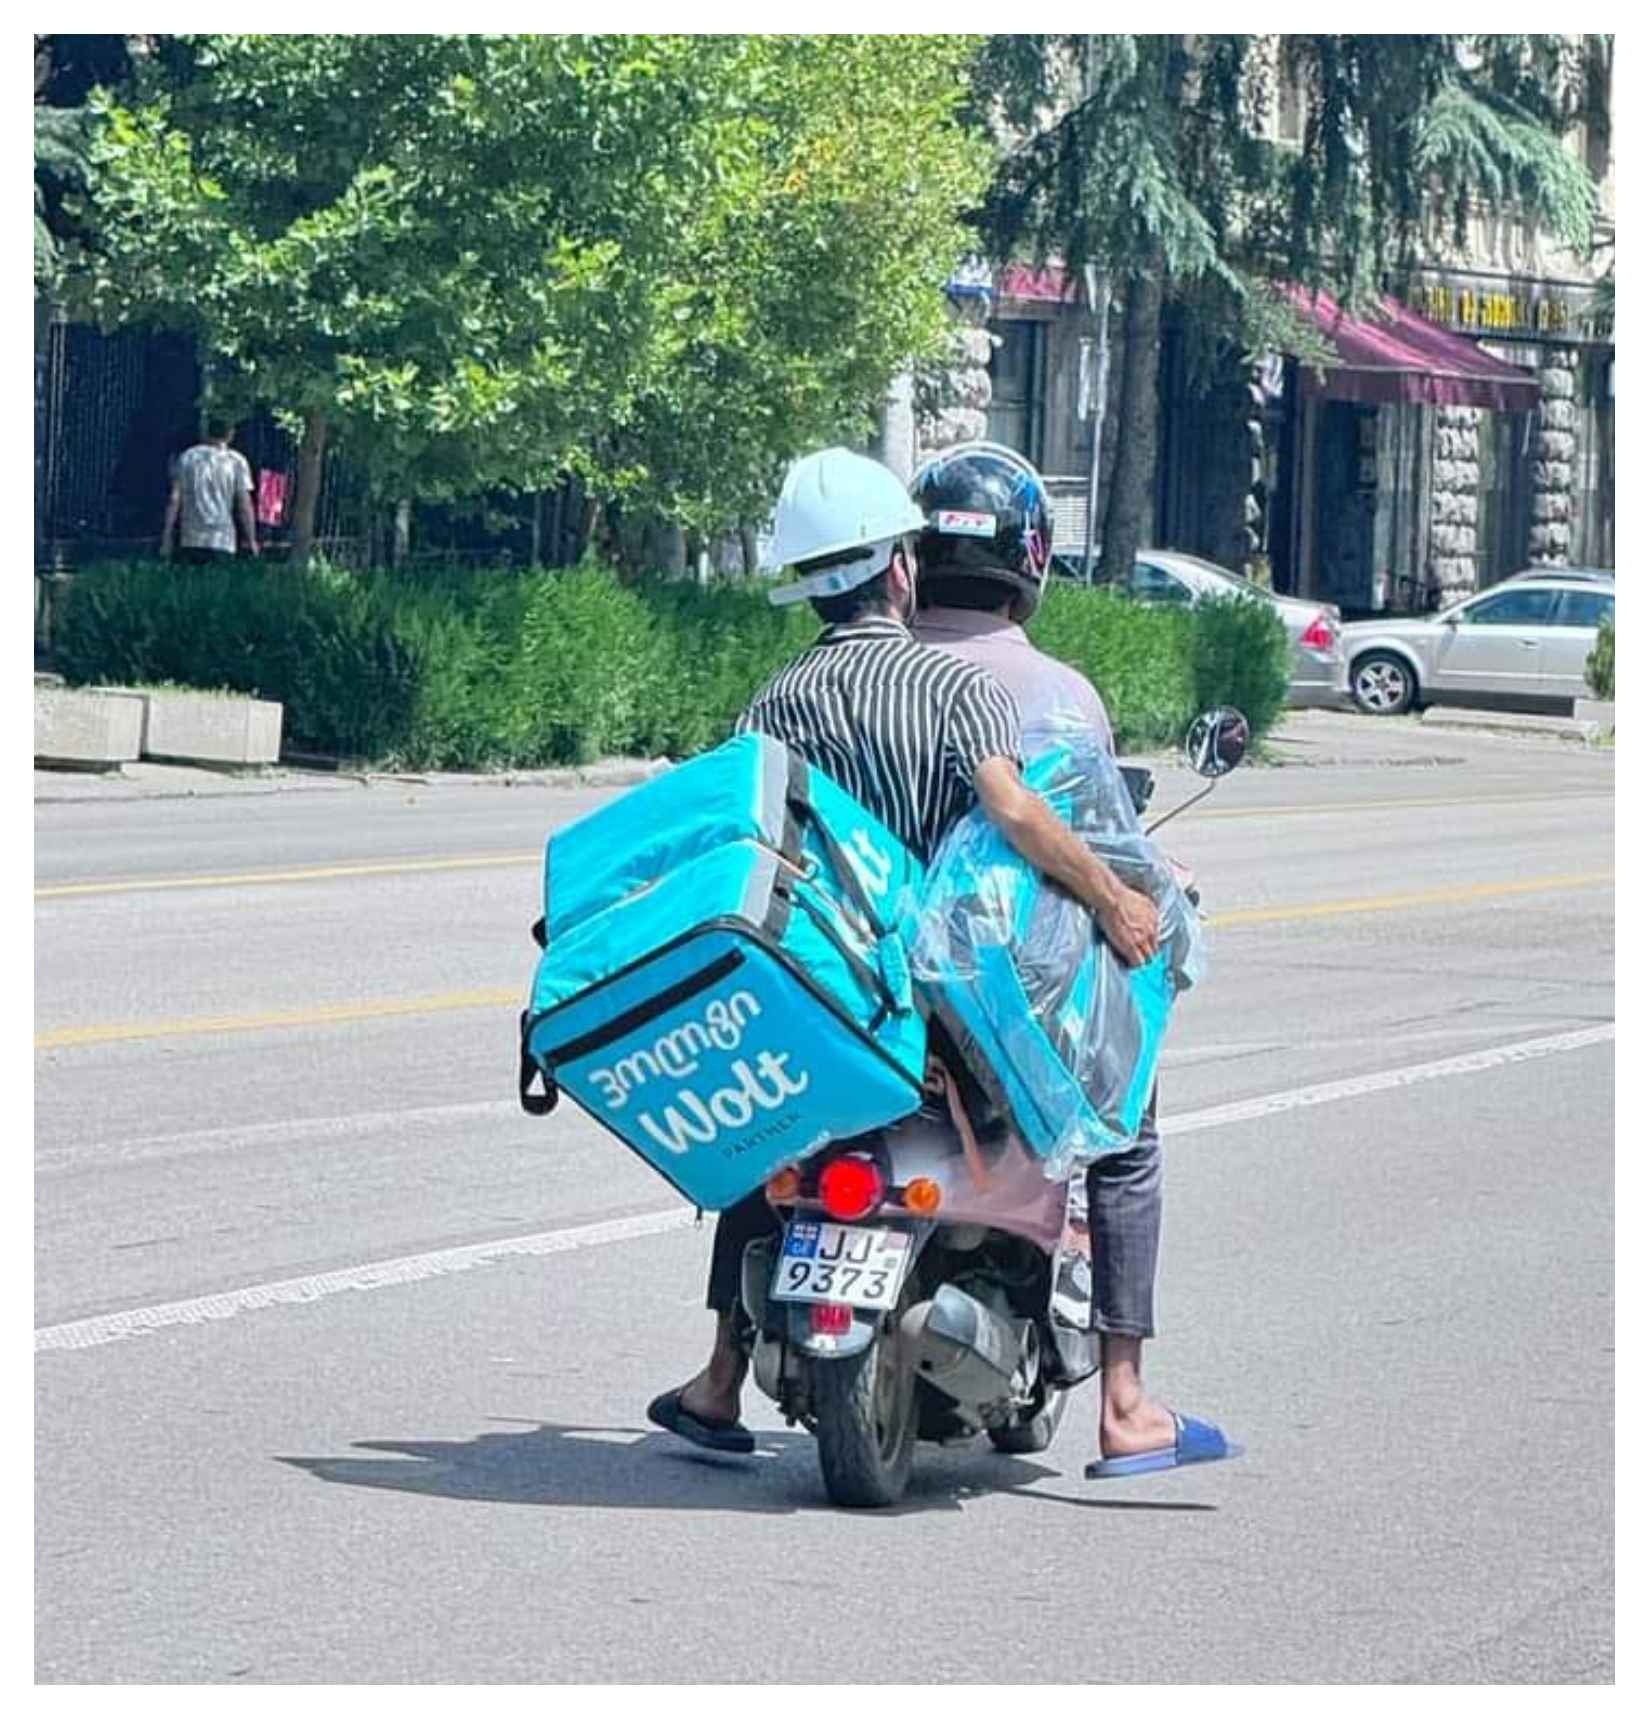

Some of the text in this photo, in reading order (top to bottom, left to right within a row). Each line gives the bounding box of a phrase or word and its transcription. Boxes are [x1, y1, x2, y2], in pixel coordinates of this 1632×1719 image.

[587, 990, 762, 1109] ვოლტი
[637, 1050, 808, 1153] Wolt
[789, 1261, 889, 1299] 9373
[819, 1230, 874, 1264] JJ
